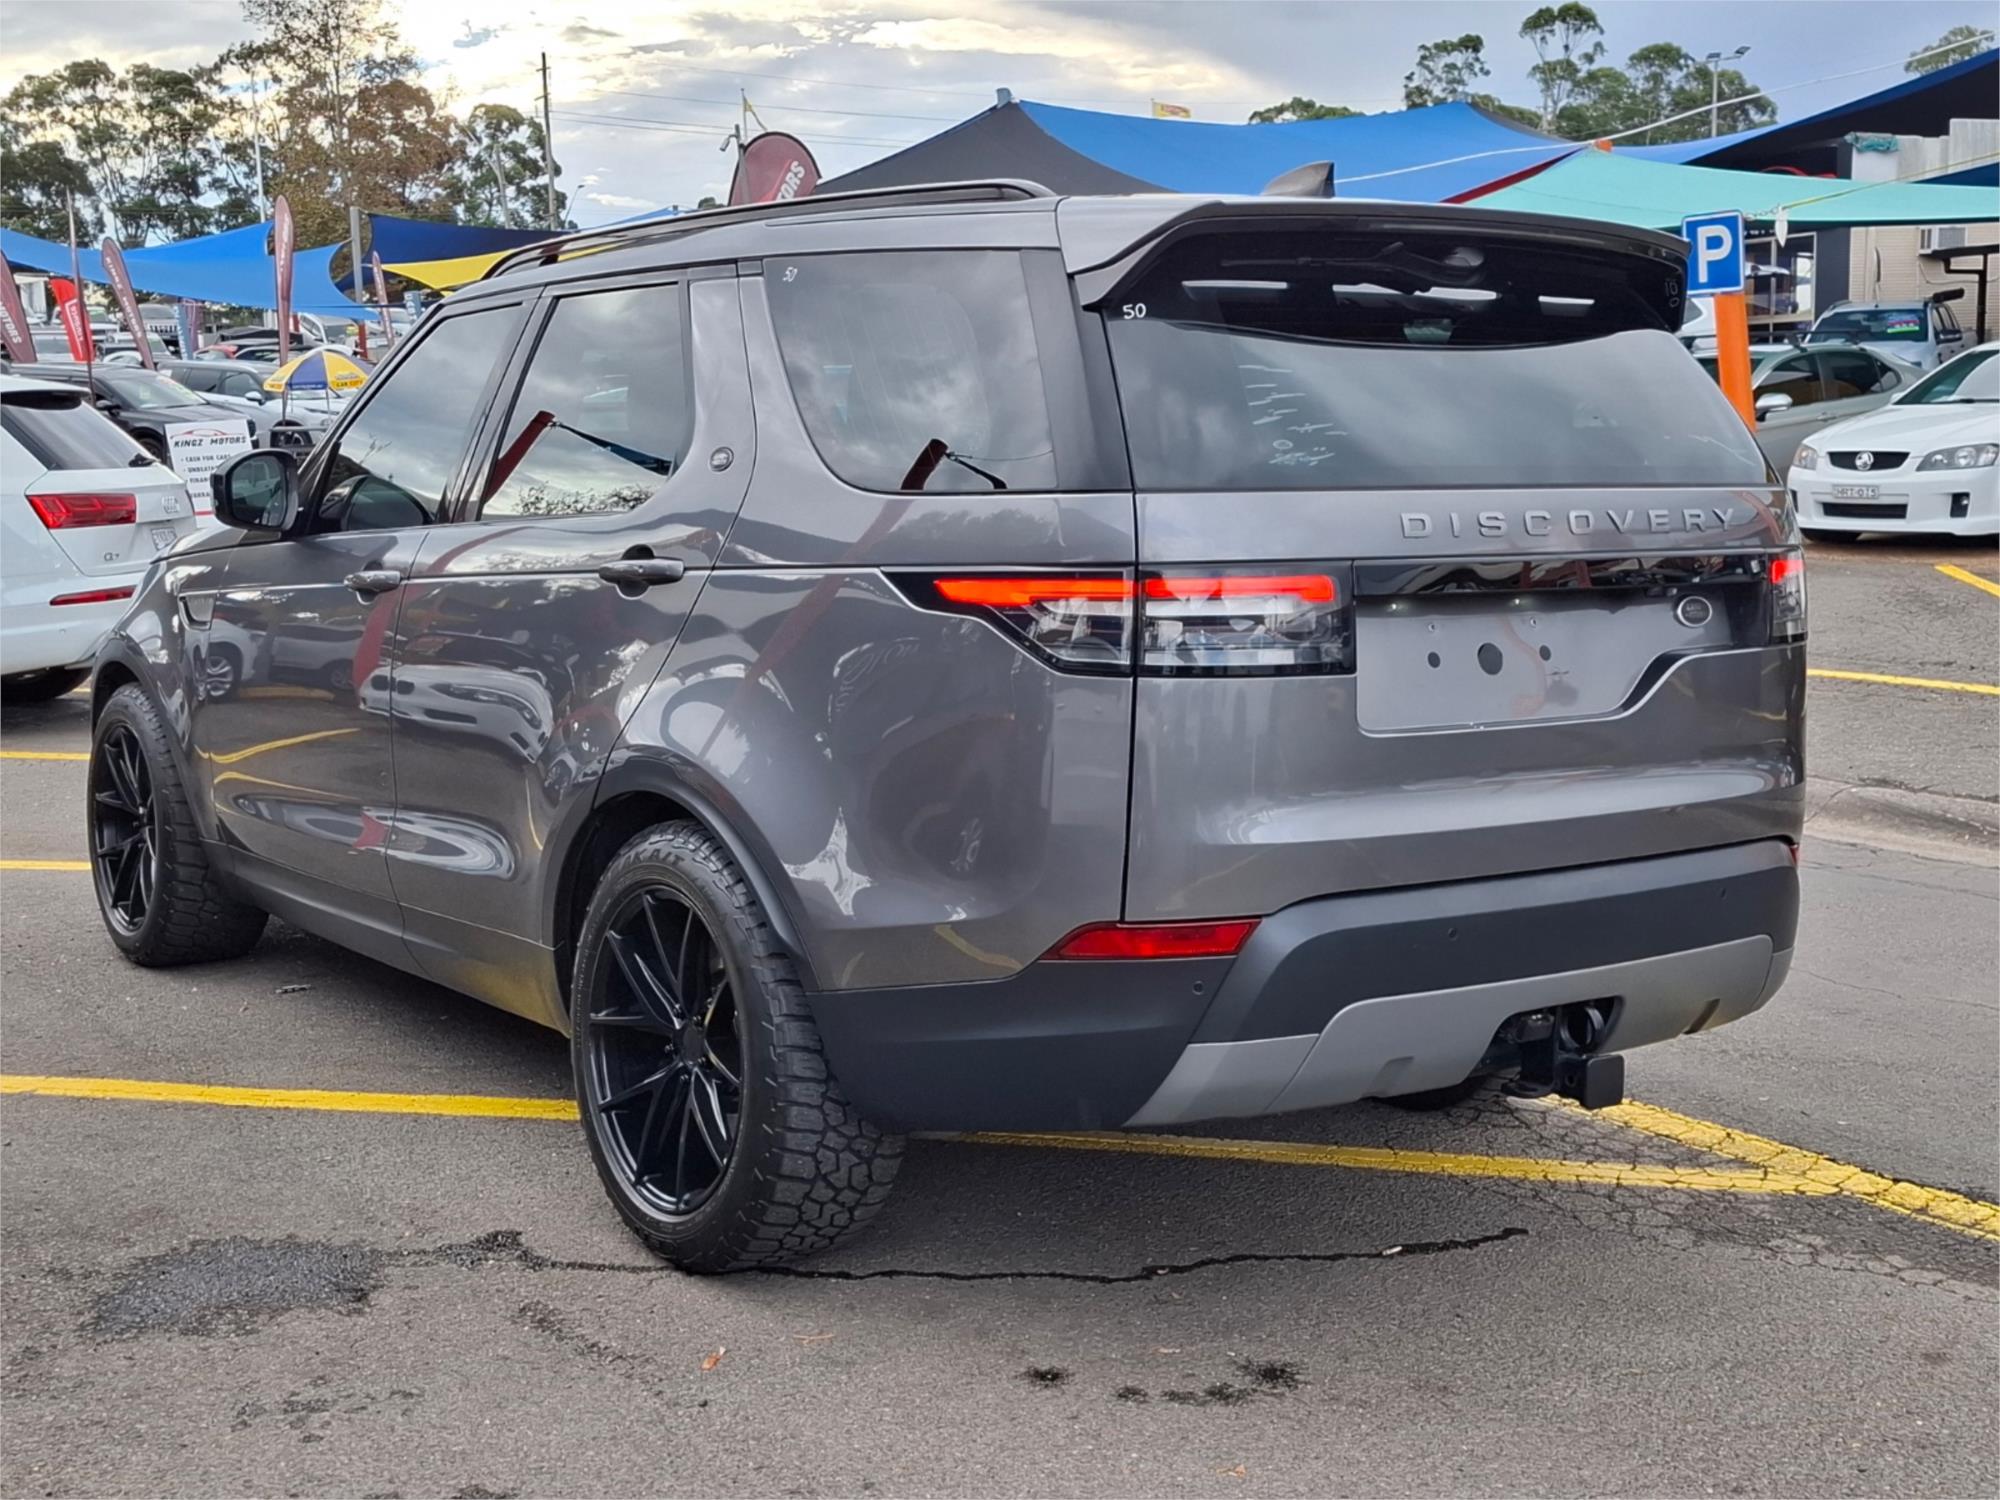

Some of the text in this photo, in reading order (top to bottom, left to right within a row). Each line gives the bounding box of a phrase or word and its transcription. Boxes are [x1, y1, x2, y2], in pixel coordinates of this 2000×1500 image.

[1697, 224, 1733, 284] P
[1122, 303, 1147, 319] 50
[174, 436, 247, 448] KINGZ MOTORS
[1400, 507, 1734, 538] DISCOVERY
